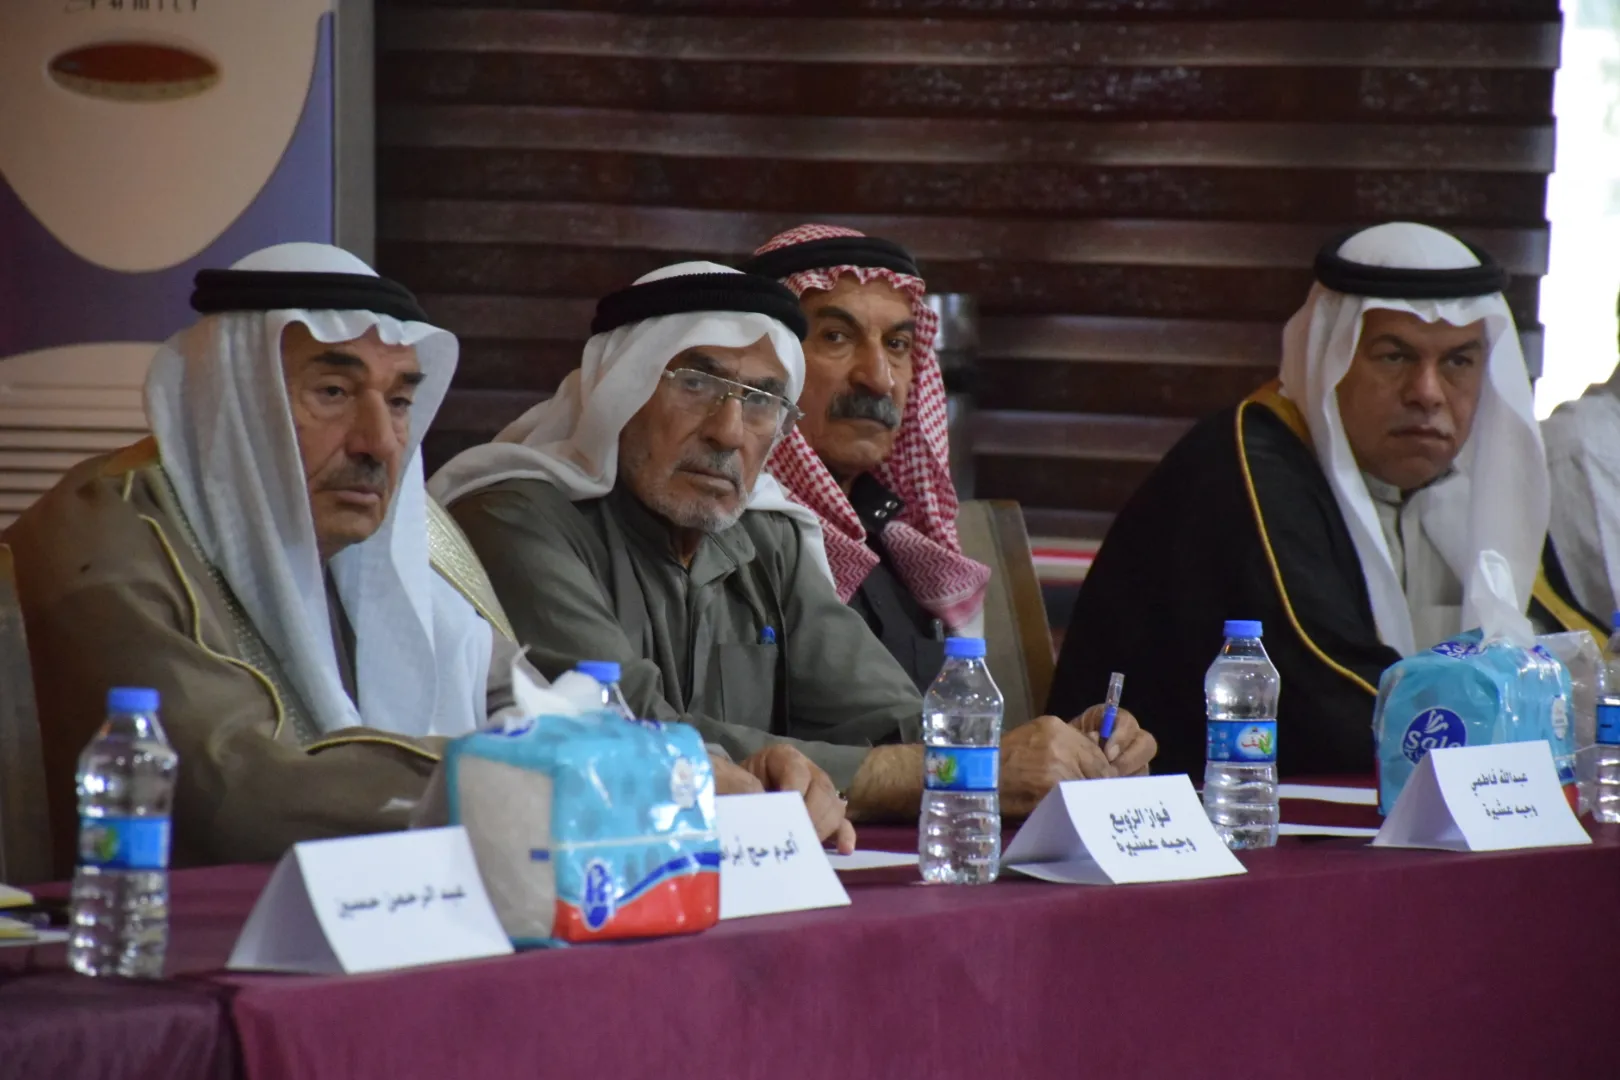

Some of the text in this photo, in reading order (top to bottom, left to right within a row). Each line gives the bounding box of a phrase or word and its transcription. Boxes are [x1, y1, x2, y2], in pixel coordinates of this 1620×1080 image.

[1145, 800, 1172, 829] فواز
[1482, 799, 1514, 821] عشيرة
[1111, 834, 1197, 858] وجيه عشيرة
